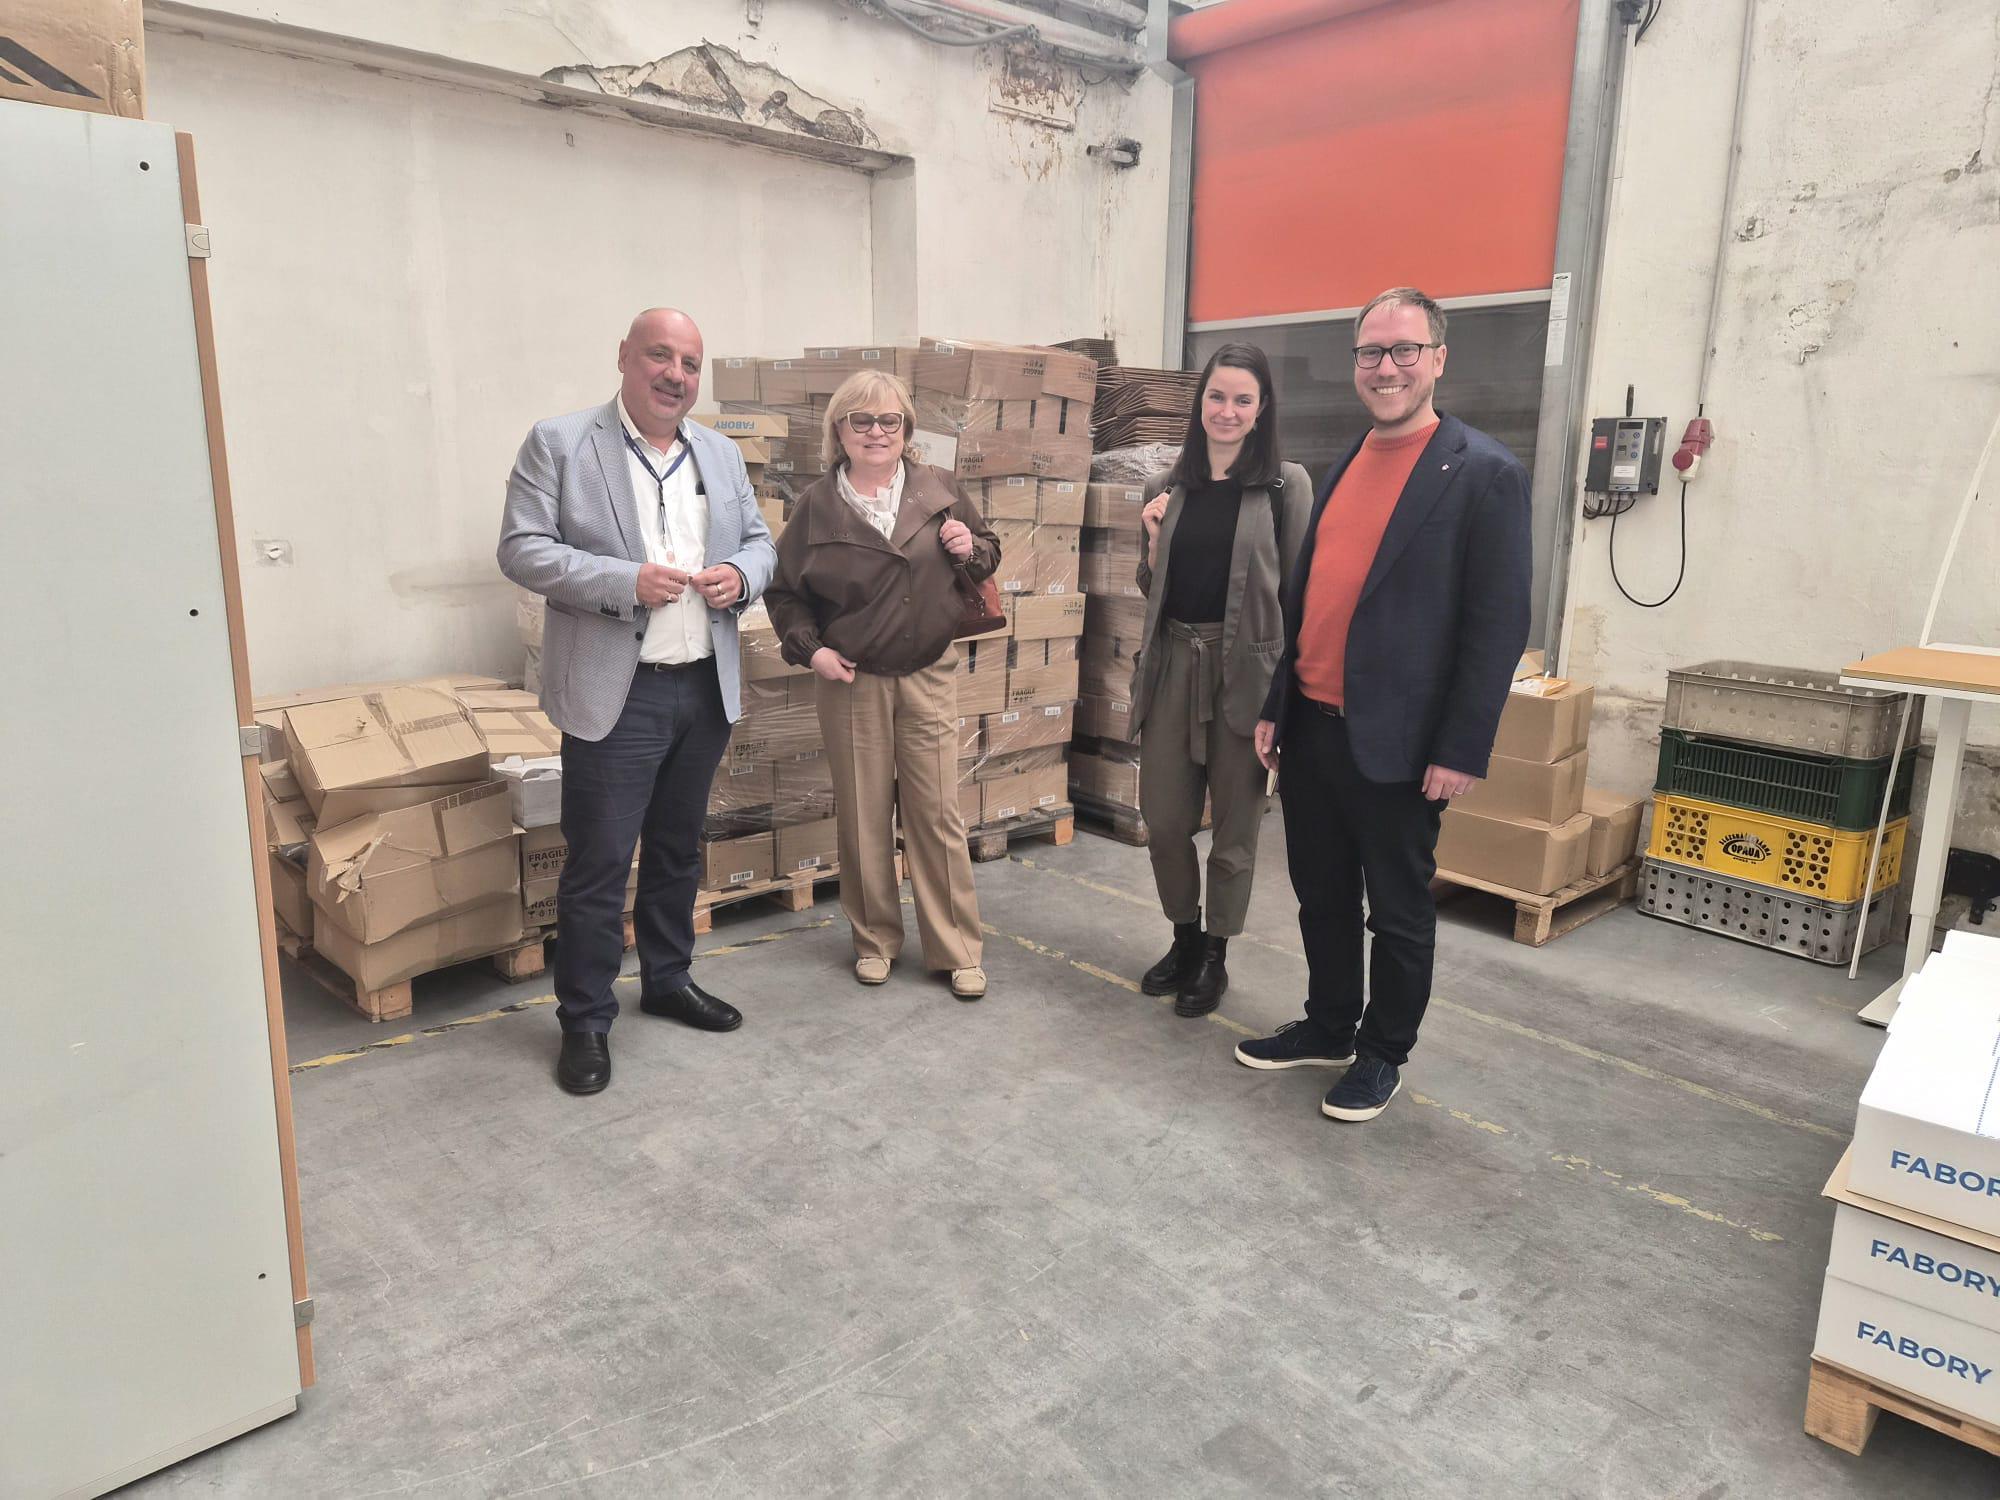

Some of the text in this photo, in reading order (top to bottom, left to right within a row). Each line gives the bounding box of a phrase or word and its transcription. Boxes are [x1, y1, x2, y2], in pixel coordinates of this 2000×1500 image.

[714, 420, 755, 430] FABORY
[960, 456, 984, 464] FRAGILE
[529, 848, 569, 862] FRAGILE
[1857, 1321, 1992, 1384] FABORY
